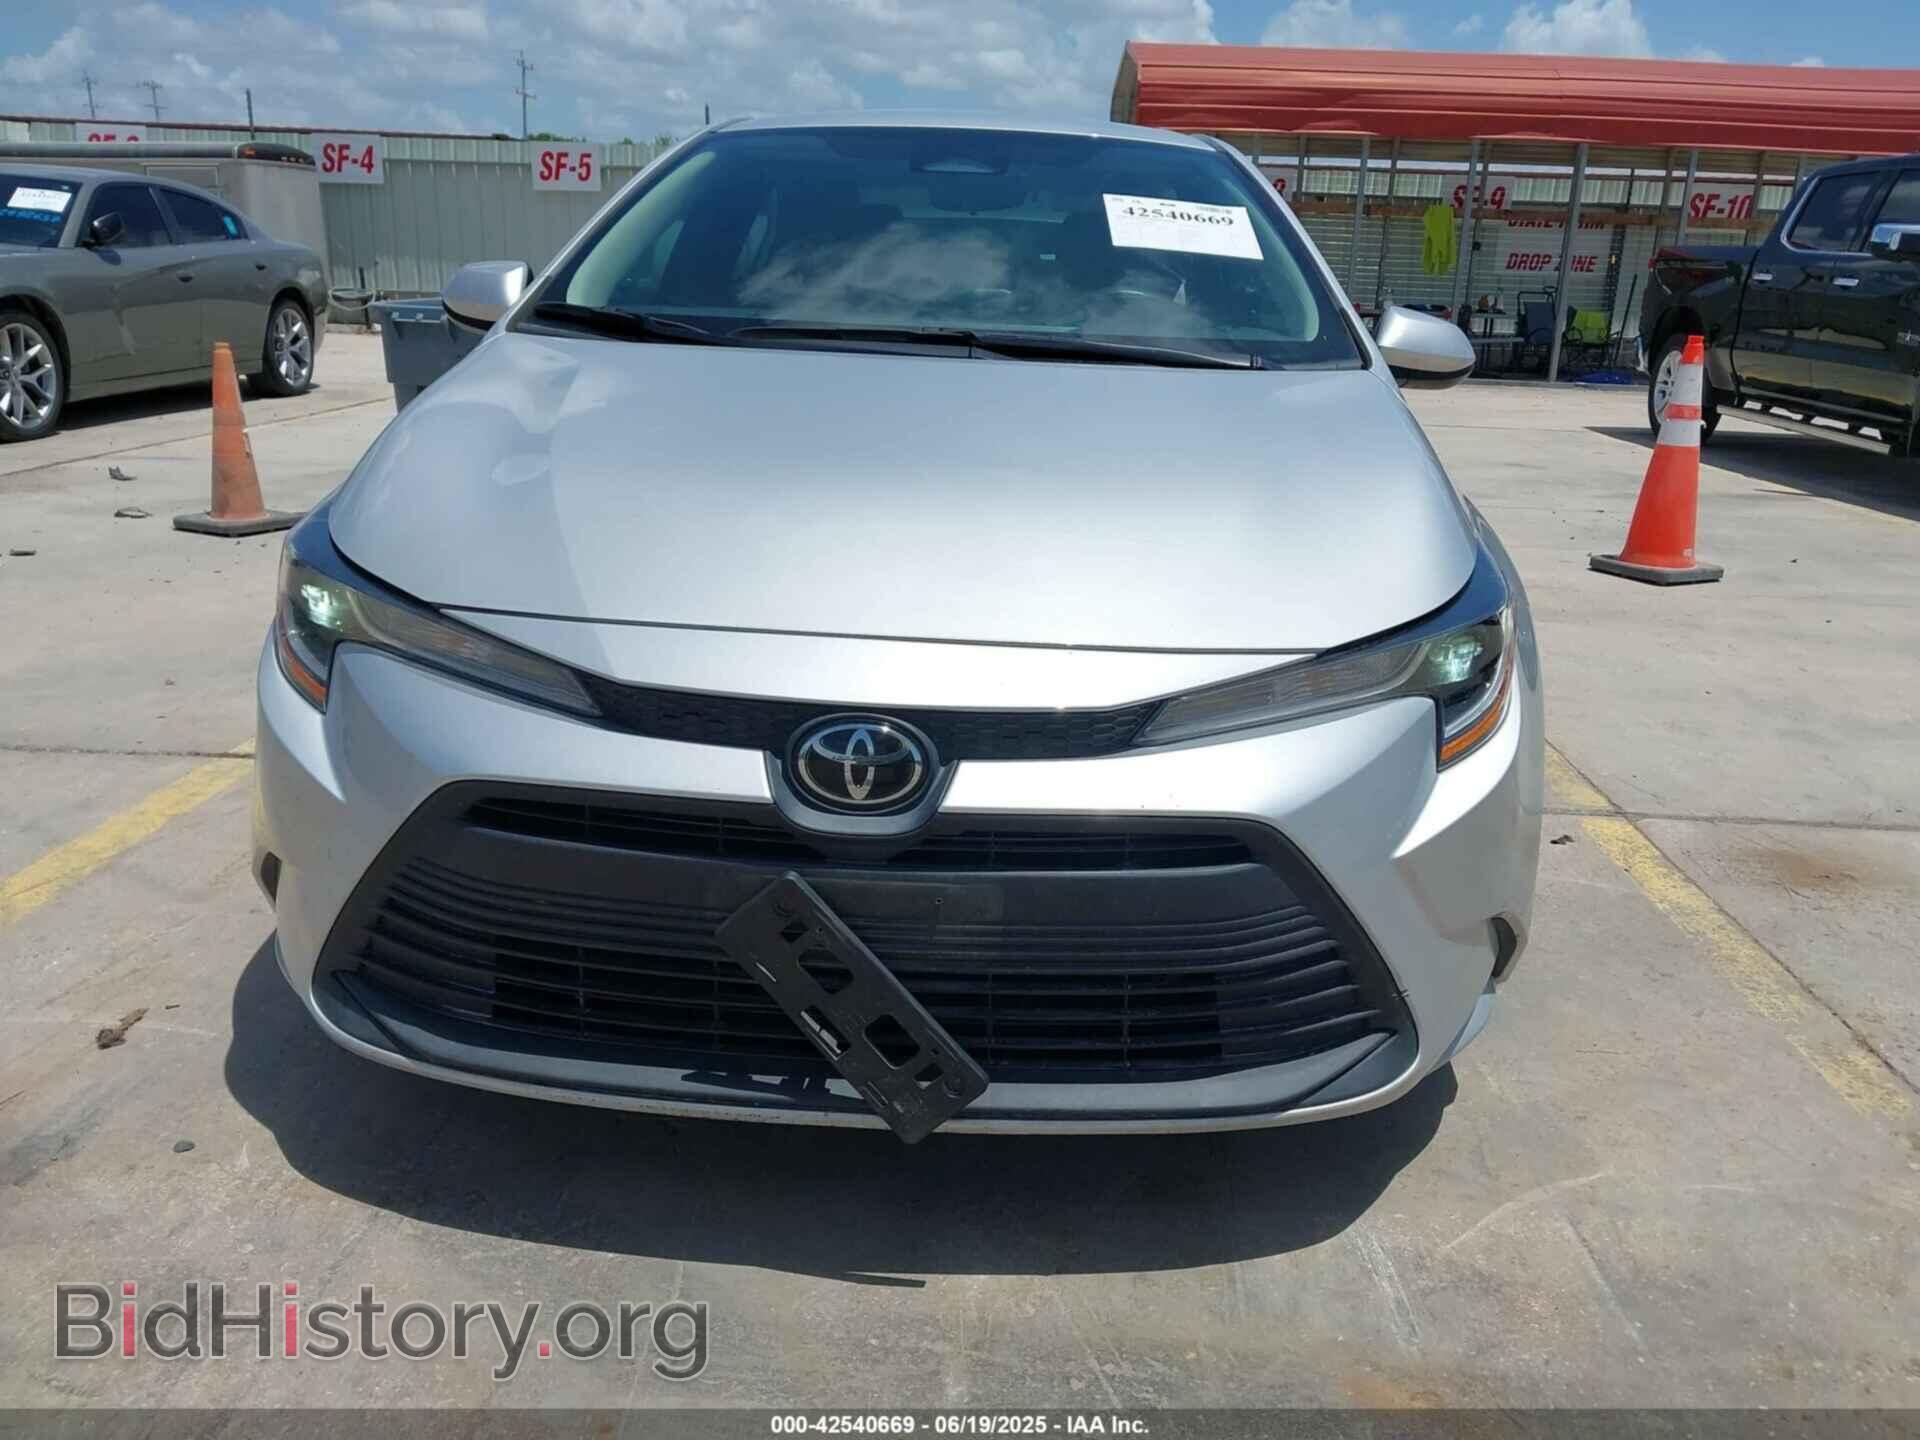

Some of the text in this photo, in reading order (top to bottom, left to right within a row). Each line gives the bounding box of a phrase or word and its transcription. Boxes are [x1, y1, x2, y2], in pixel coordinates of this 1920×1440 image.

[322, 143, 374, 174] SF-4
[539, 150, 592, 182] SF-5
[1122, 205, 1235, 226] 42540669
[1689, 192, 1754, 219] SF-10
[1505, 253, 1599, 273] DROP NE
